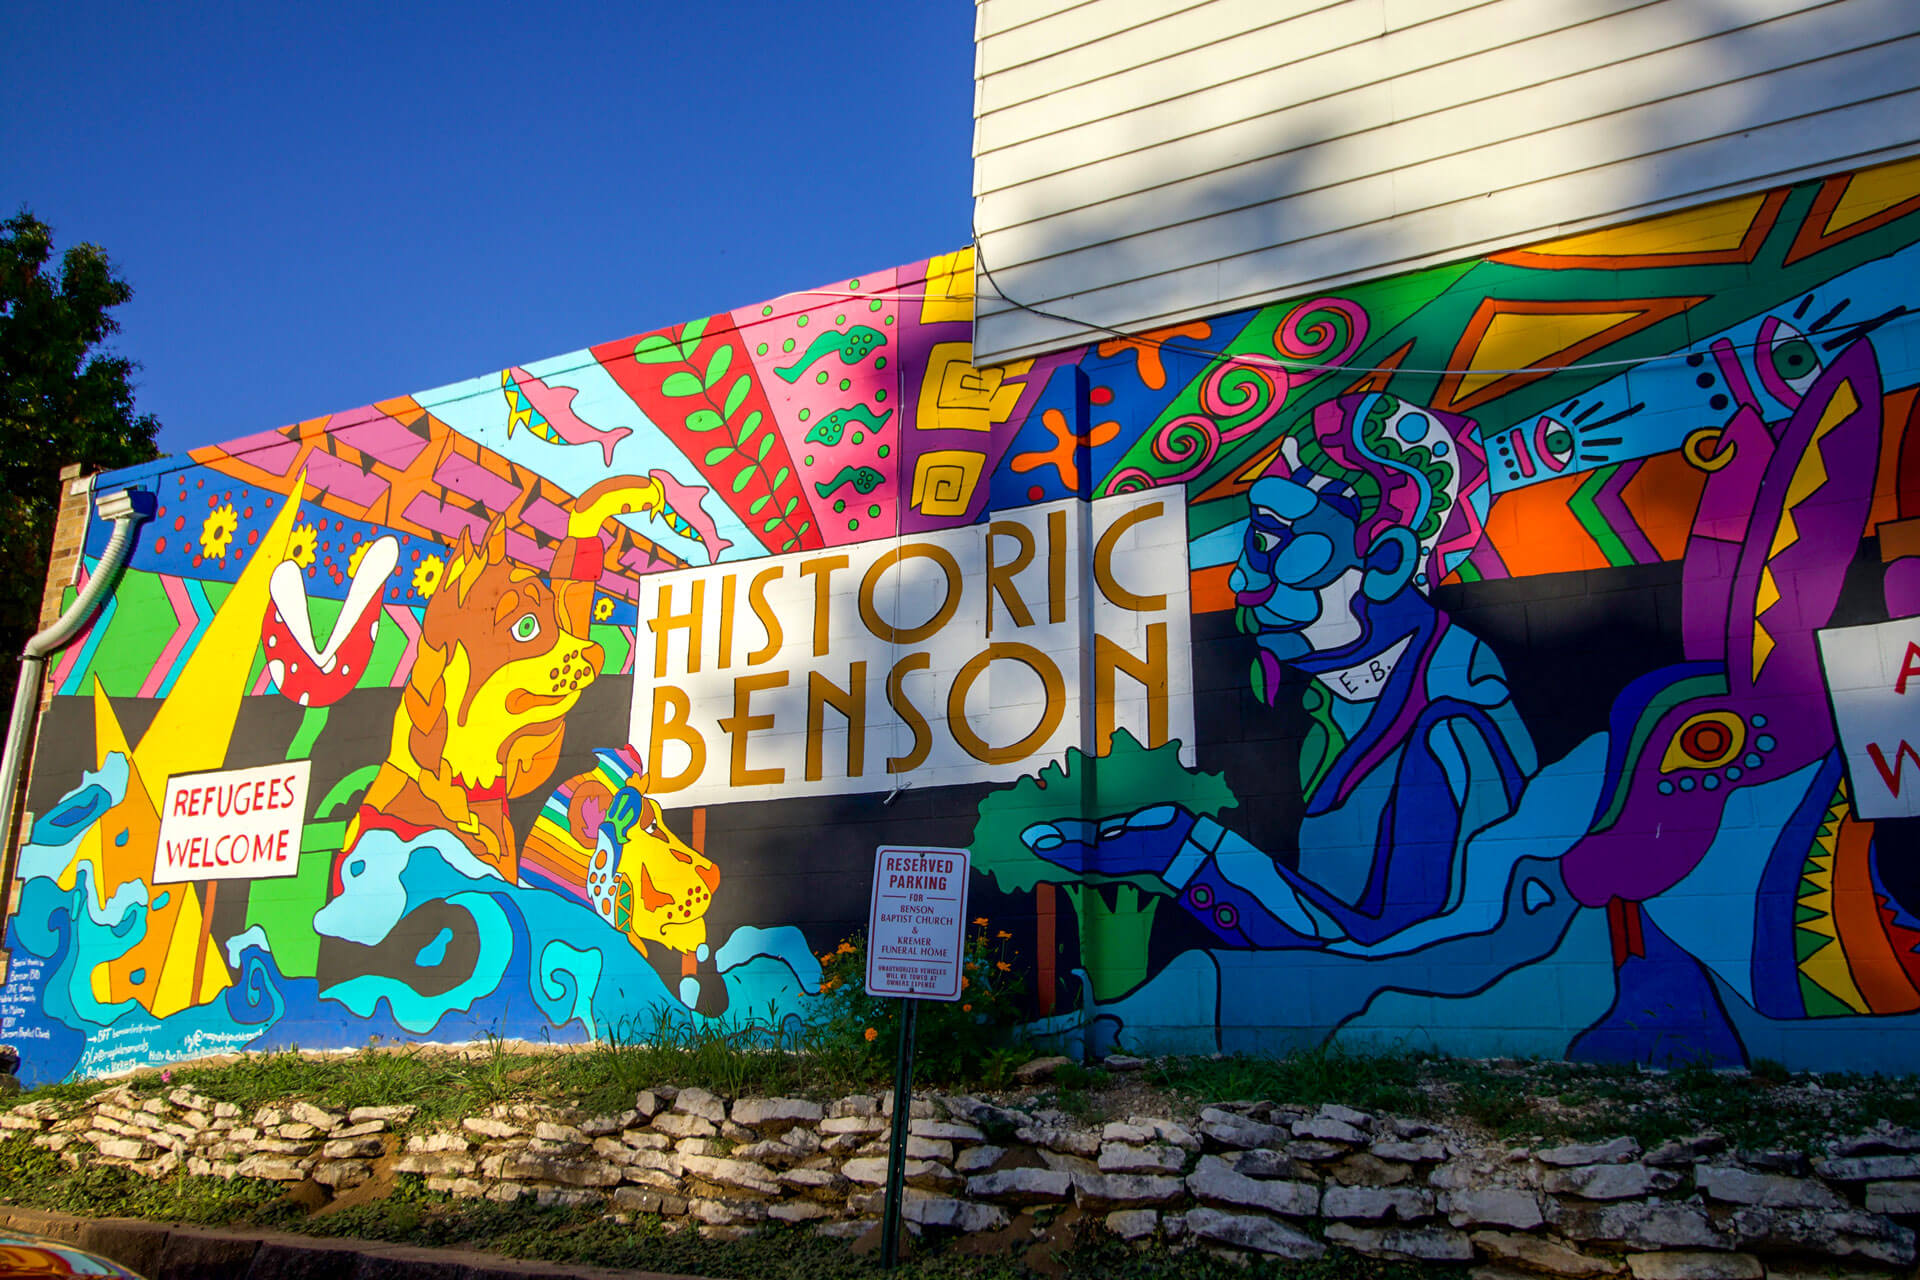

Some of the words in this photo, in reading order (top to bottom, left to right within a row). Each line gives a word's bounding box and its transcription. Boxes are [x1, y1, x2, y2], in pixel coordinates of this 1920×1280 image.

[647, 501, 1167, 679] HISTORIC
[646, 621, 1168, 795] BENSON
[173, 775, 296, 818] REFUGEES
[166, 829, 289, 868] WELCOME
[886, 857, 954, 874] RESERVED
[889, 874, 948, 891] PARKING
[909, 893, 924, 902] FOR
[900, 904, 935, 914] BENSON
[880, 913, 912, 924] BAPTIST
[915, 915, 953, 926] CHURCH
[911, 927, 919, 935] &
[897, 936, 932, 946] KREMER
[881, 945, 918, 955] FUNERAL
[920, 947, 948, 957] HOME
[878, 965, 919, 973] UNAUTHORIZED
